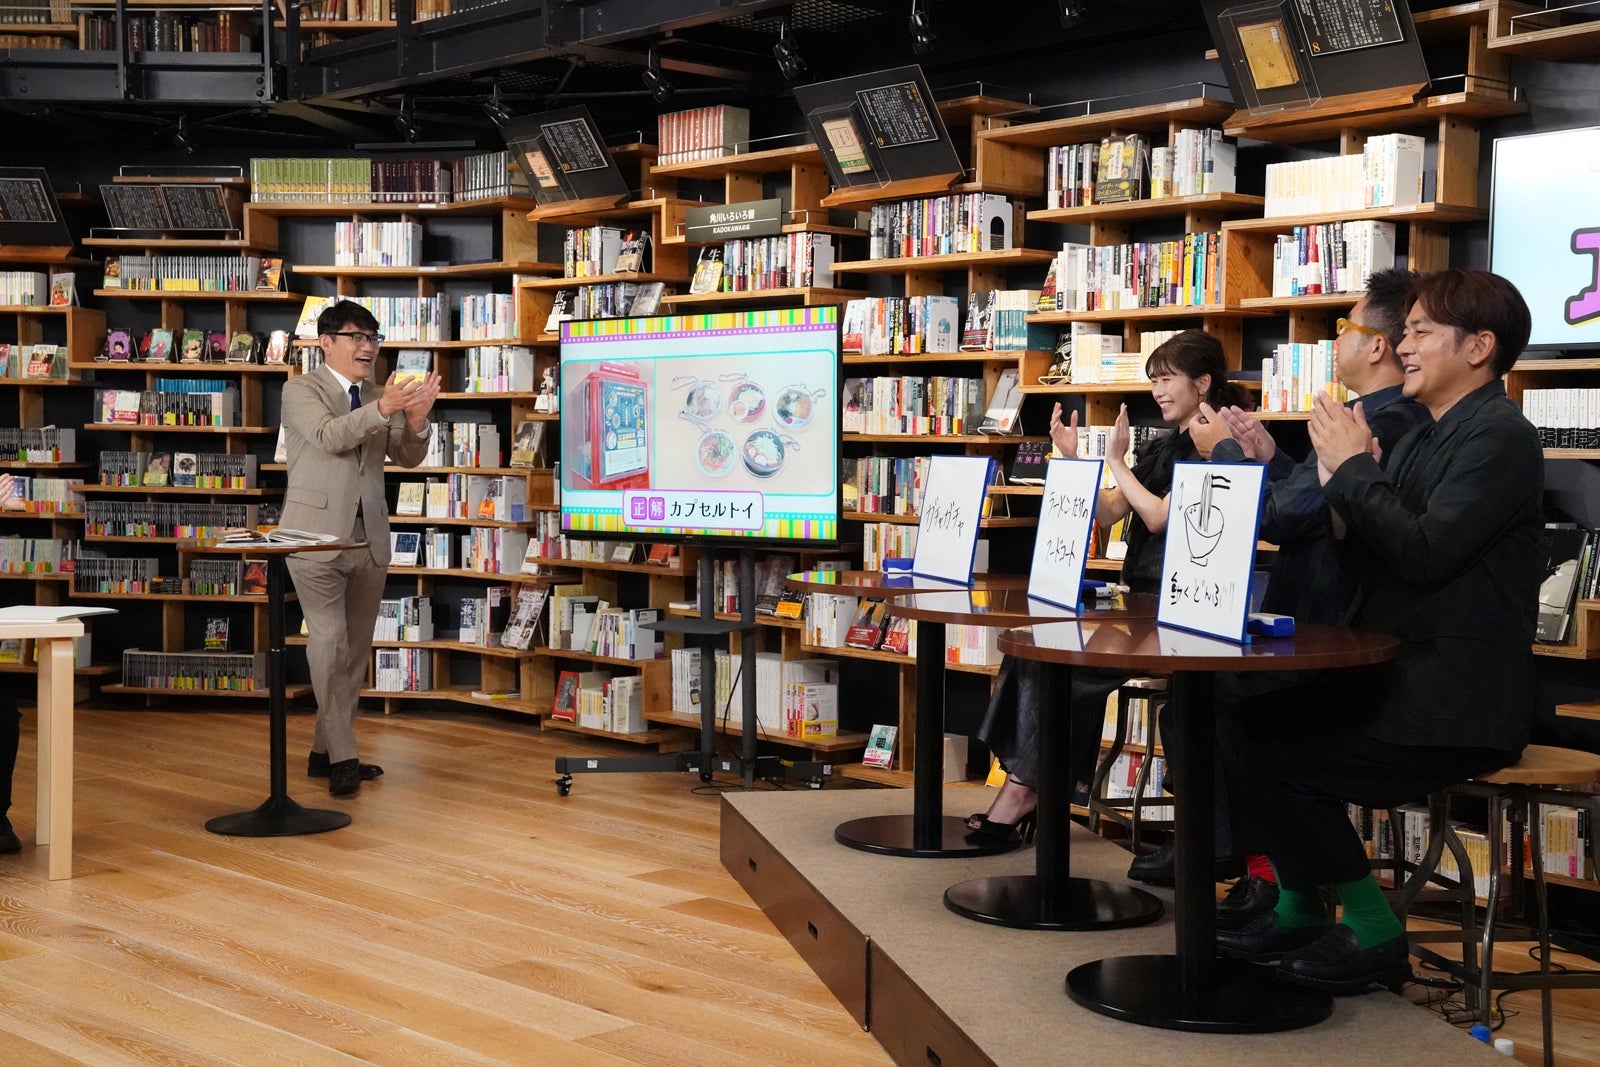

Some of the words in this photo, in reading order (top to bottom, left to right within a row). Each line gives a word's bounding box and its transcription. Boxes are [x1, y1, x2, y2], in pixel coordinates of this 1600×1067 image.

[1312, 42, 1321, 53] 8
[877, 137, 885, 146] 9
[1018, 442, 1044, 452] もうどく
[1016, 455, 1042, 464] 水族館
[634, 500, 663, 517] 正解
[670, 499, 754, 519] カプセルトイ
[926, 496, 964, 537] ガチャガチャ
[1045, 536, 1076, 567] フードコート
